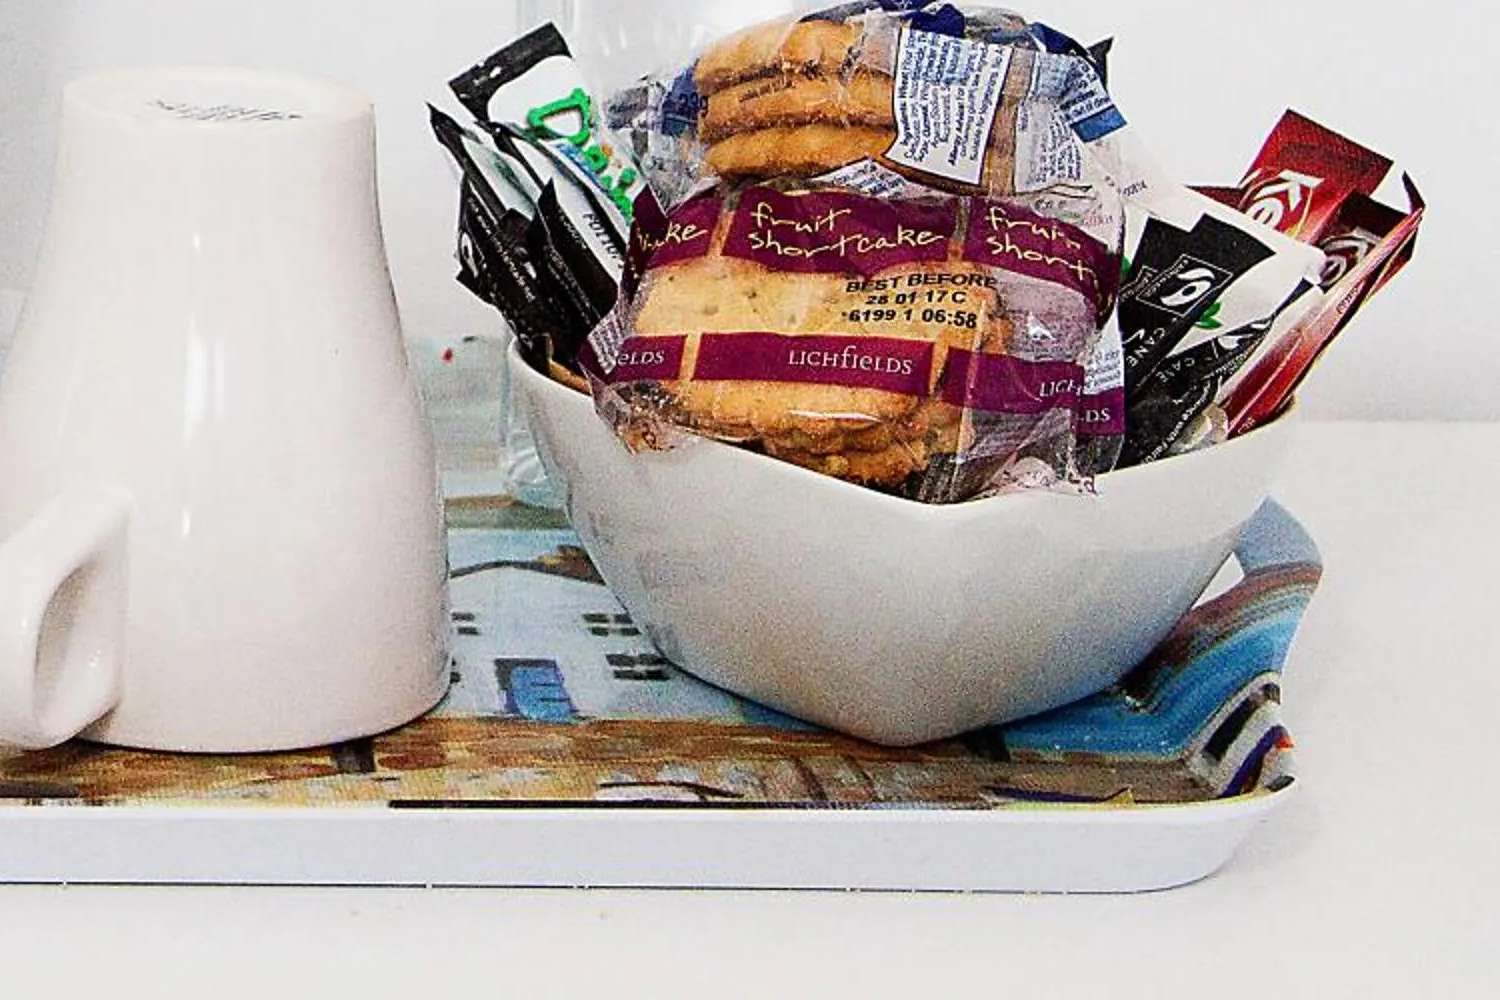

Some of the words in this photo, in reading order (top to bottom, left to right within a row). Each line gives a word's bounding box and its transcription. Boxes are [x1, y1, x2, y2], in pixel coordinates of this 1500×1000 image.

[751, 202, 852, 233] fruit
[750, 225, 944, 257] shortcake
[846, 275, 903, 293] BEST
[907, 273, 998, 291] BEFORE
[895, 291, 917, 305] 01
[903, 308, 913, 321] 1
[921, 308, 977, 329] 06:58
